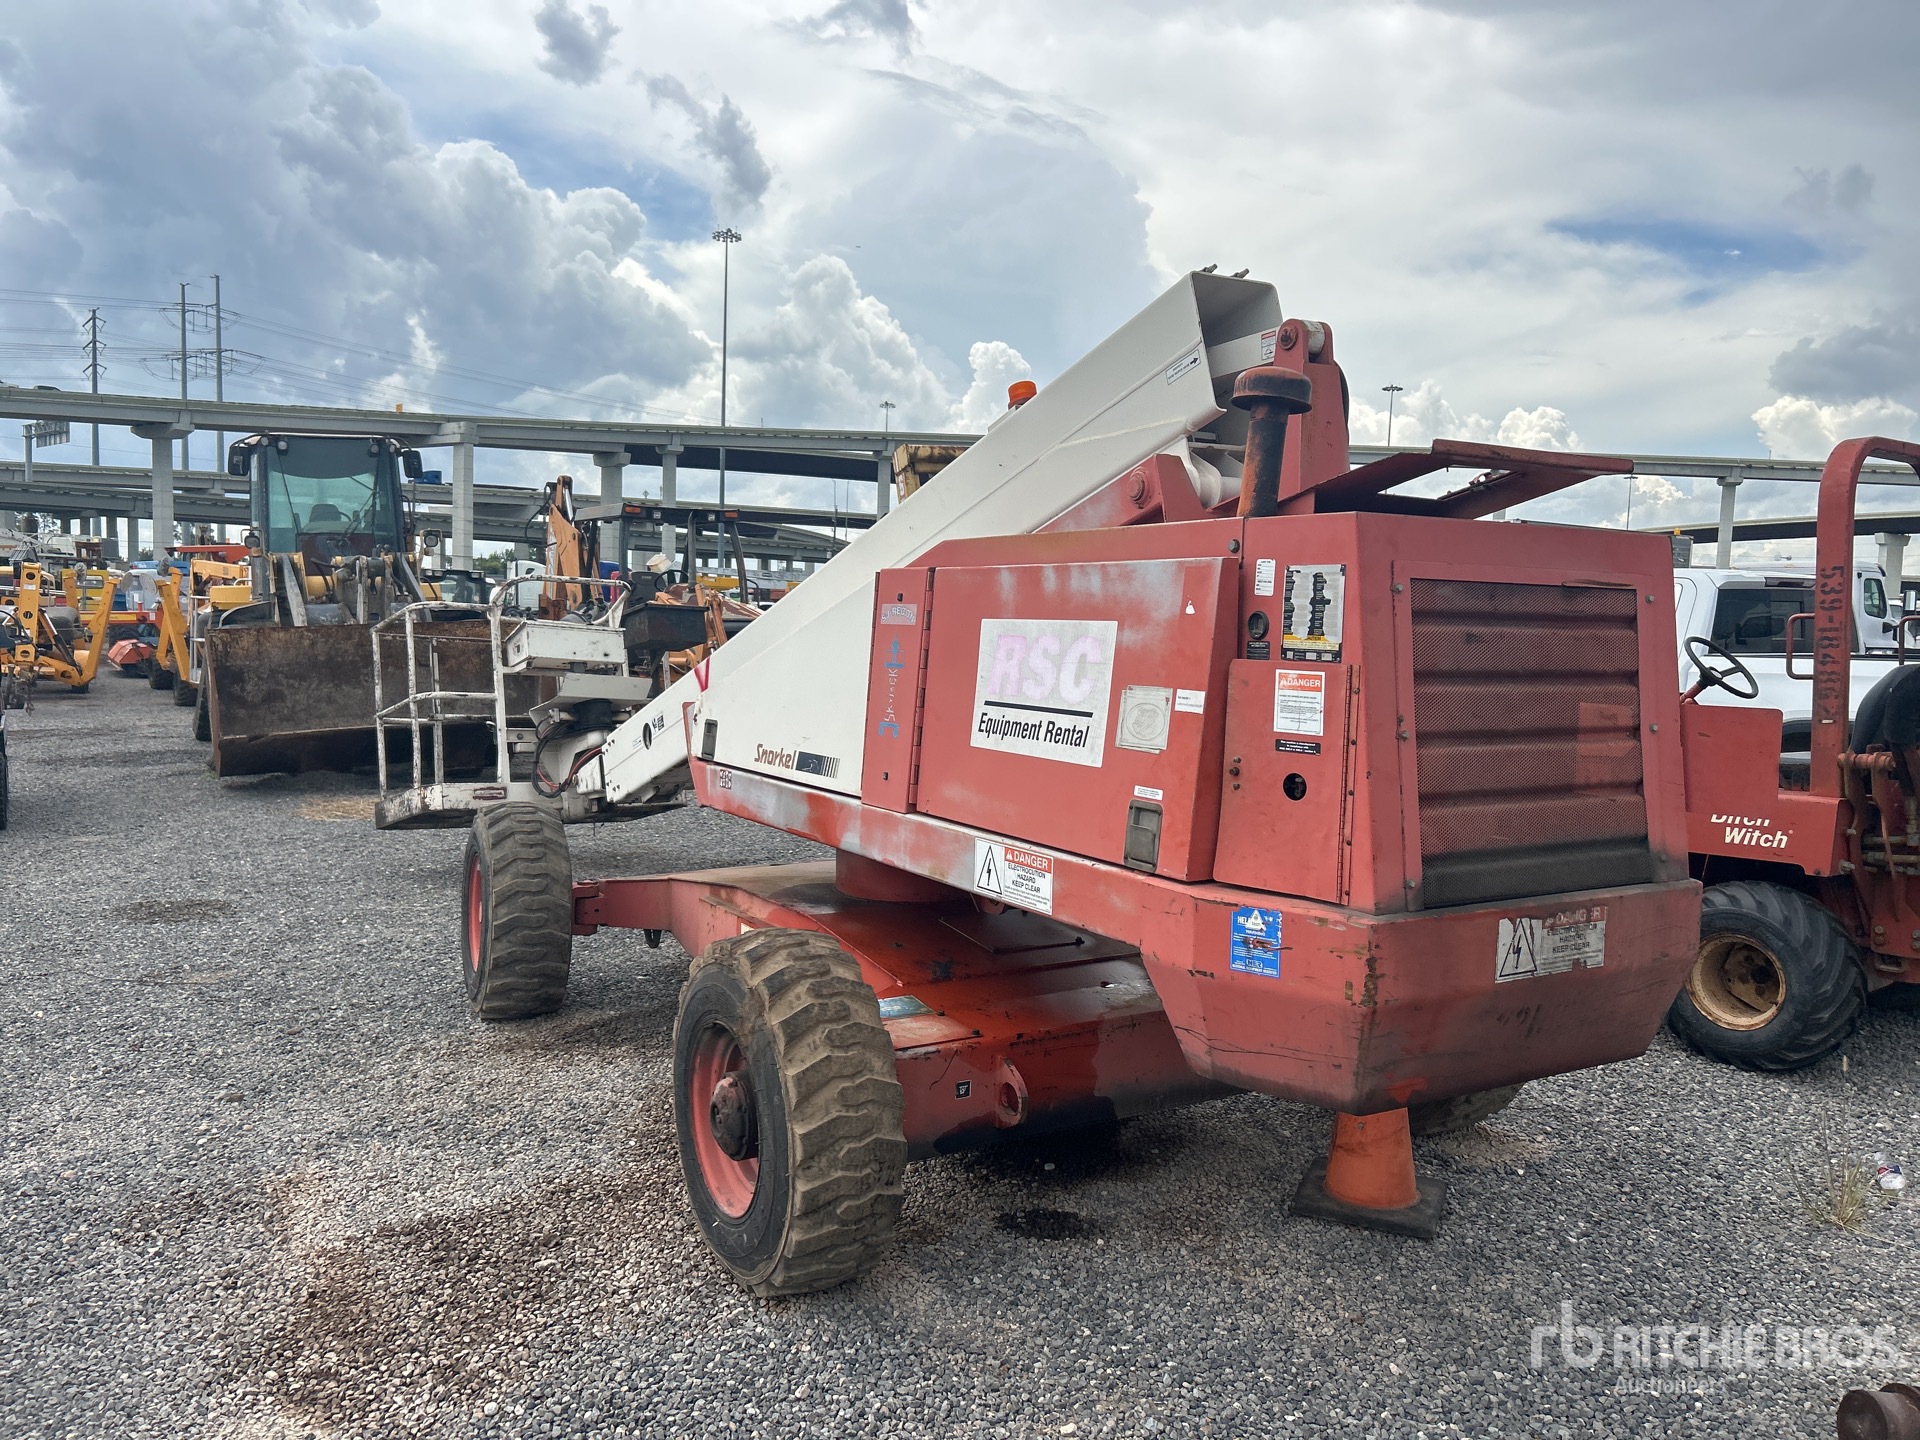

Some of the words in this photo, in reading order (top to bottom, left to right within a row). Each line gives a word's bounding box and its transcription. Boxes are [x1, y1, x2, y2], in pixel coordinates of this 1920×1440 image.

[987, 634, 1104, 704] RSC
[1287, 678, 1321, 688] DANGER
[978, 712, 1042, 741] Equipment
[1043, 721, 1090, 748] Rental
[754, 743, 797, 770] Snorkel
[1724, 827, 1788, 849] Witch
[1013, 850, 1049, 870] DANGER
[1008, 863, 1046, 879] ELECTROCUTION
[1017, 874, 1036, 884] HAZARD
[1012, 880, 1024, 889] KEEP
[1025, 881, 1041, 893] CLEAR
[1552, 945, 1569, 954] KEEP
[1570, 941, 1590, 951] CLEAR
